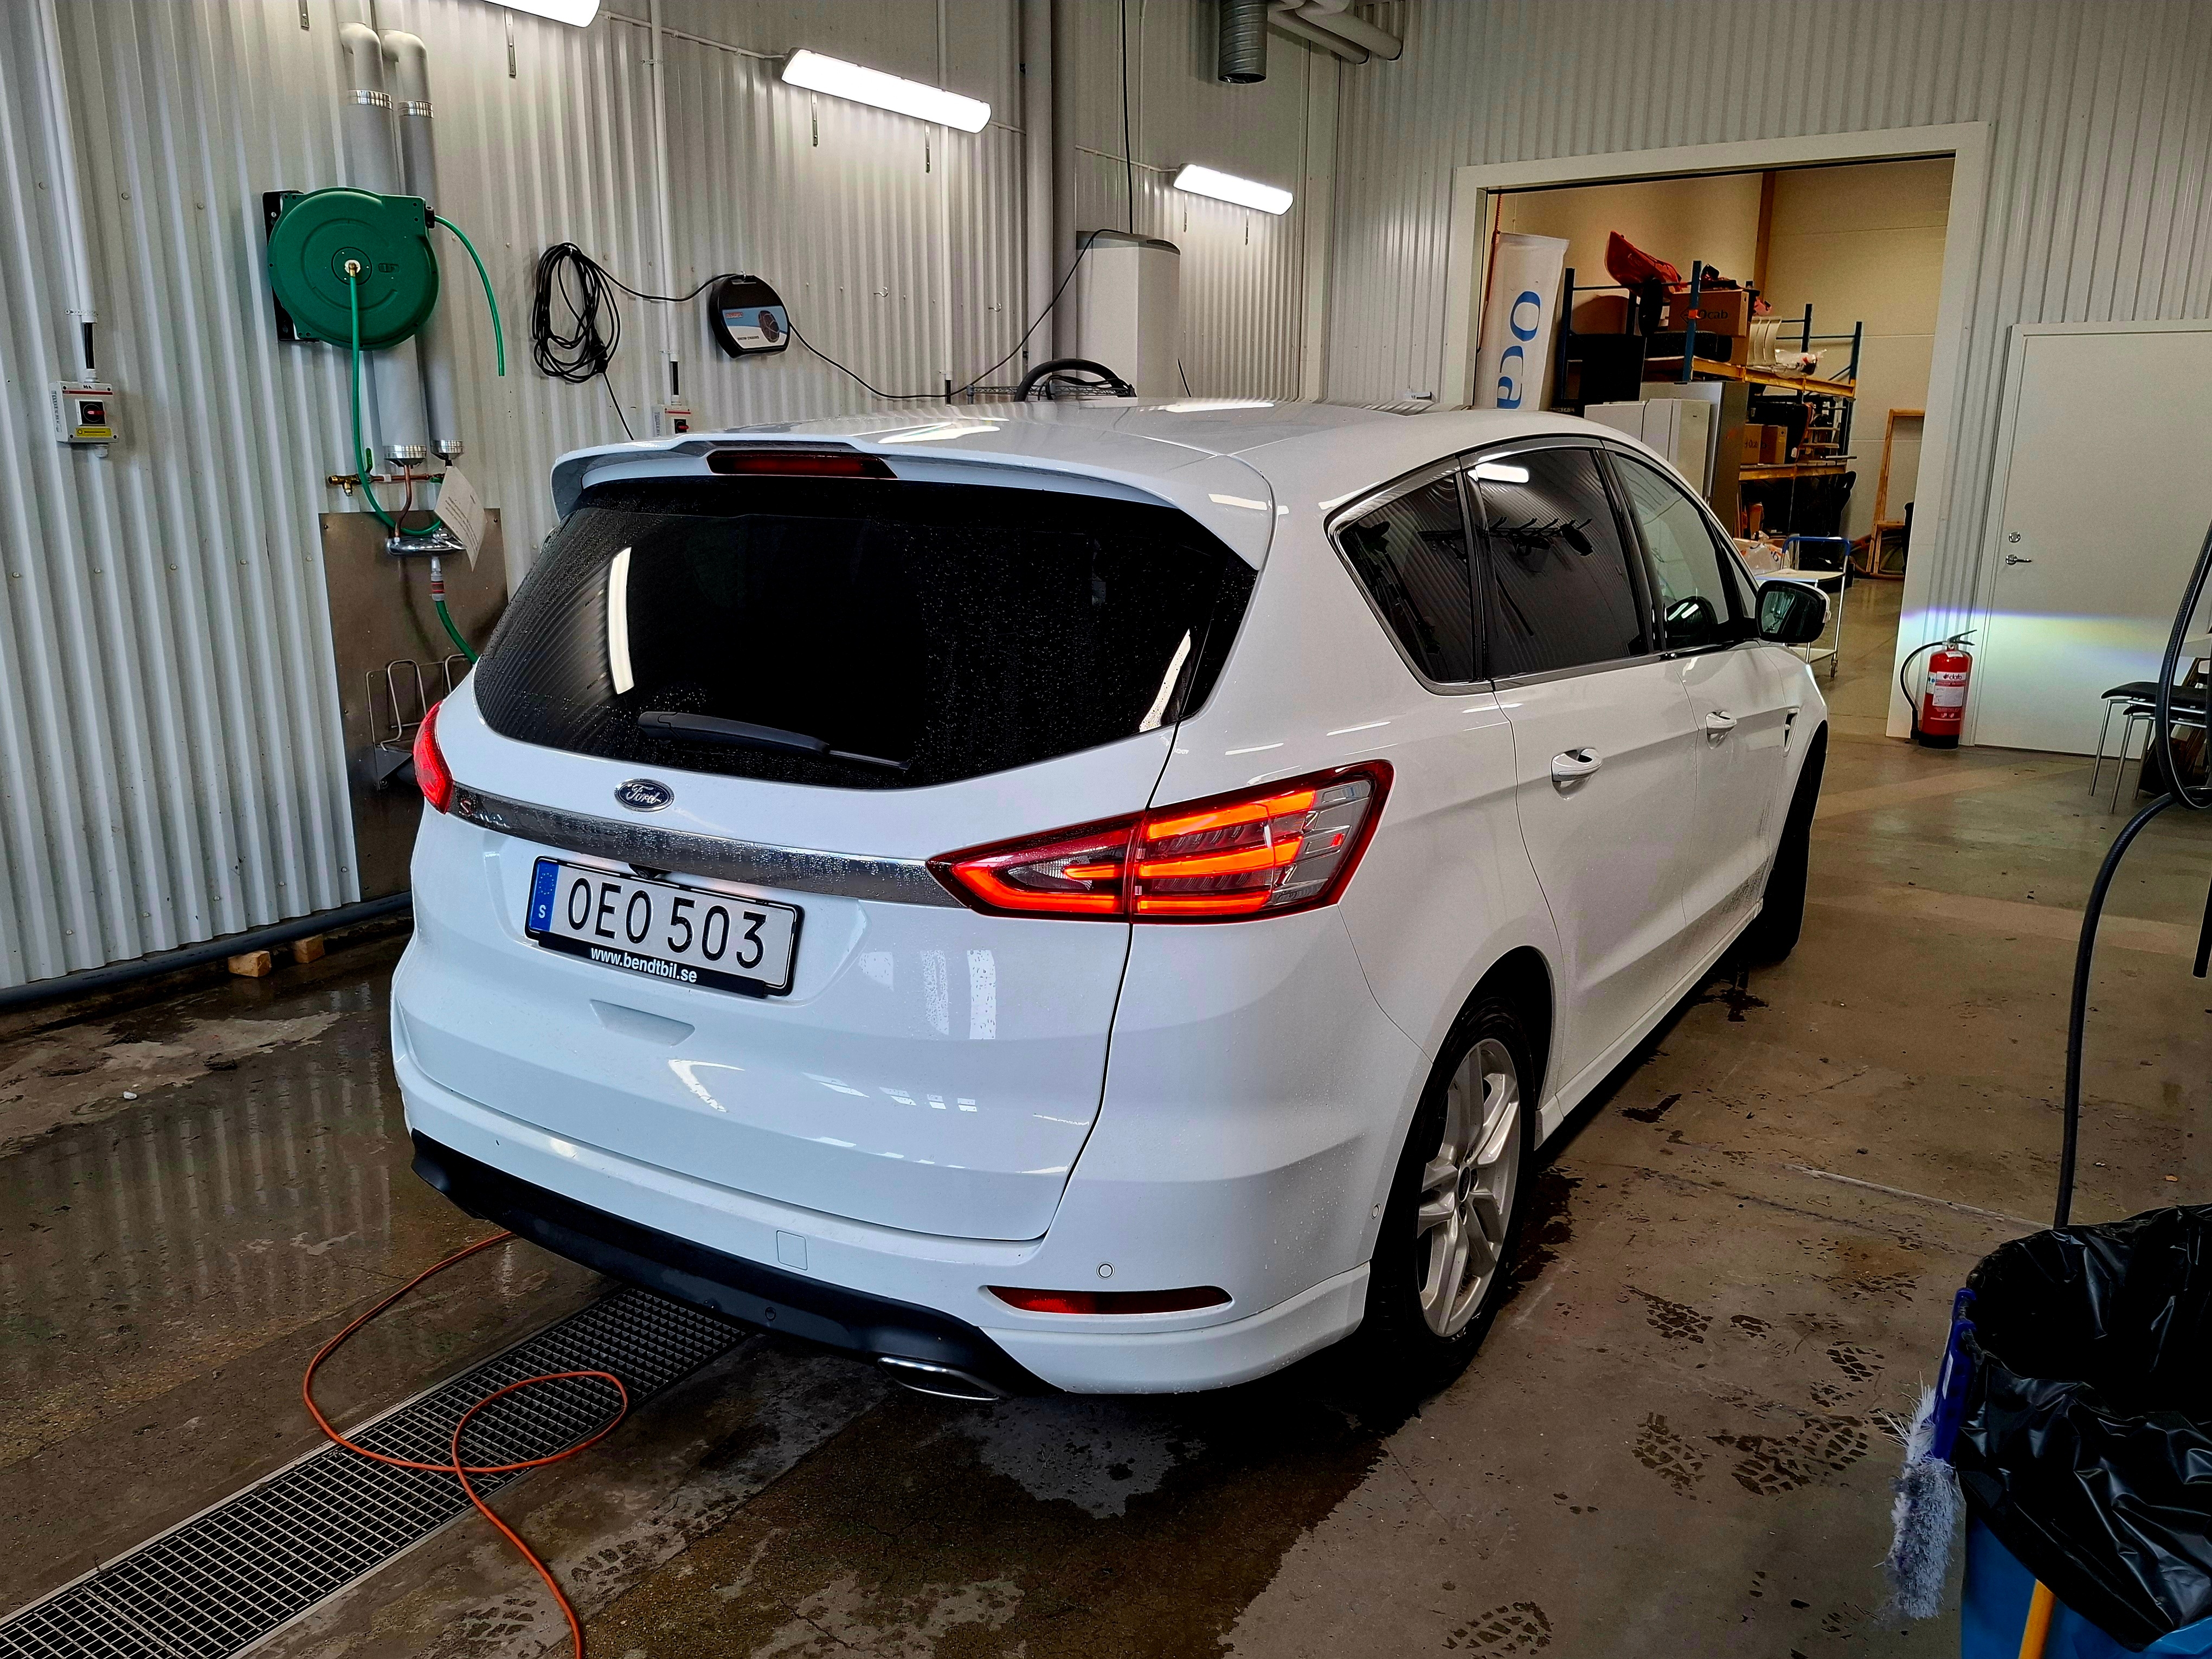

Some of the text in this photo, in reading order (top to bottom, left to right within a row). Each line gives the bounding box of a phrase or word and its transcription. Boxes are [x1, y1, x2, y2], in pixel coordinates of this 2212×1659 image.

[1697, 308, 1728, 320] Ocab
[626, 784, 661, 803] Ford
[538, 904, 547, 919] S
[568, 877, 768, 969] OEO 503
[590, 947, 697, 983] www.bendtbil.se
